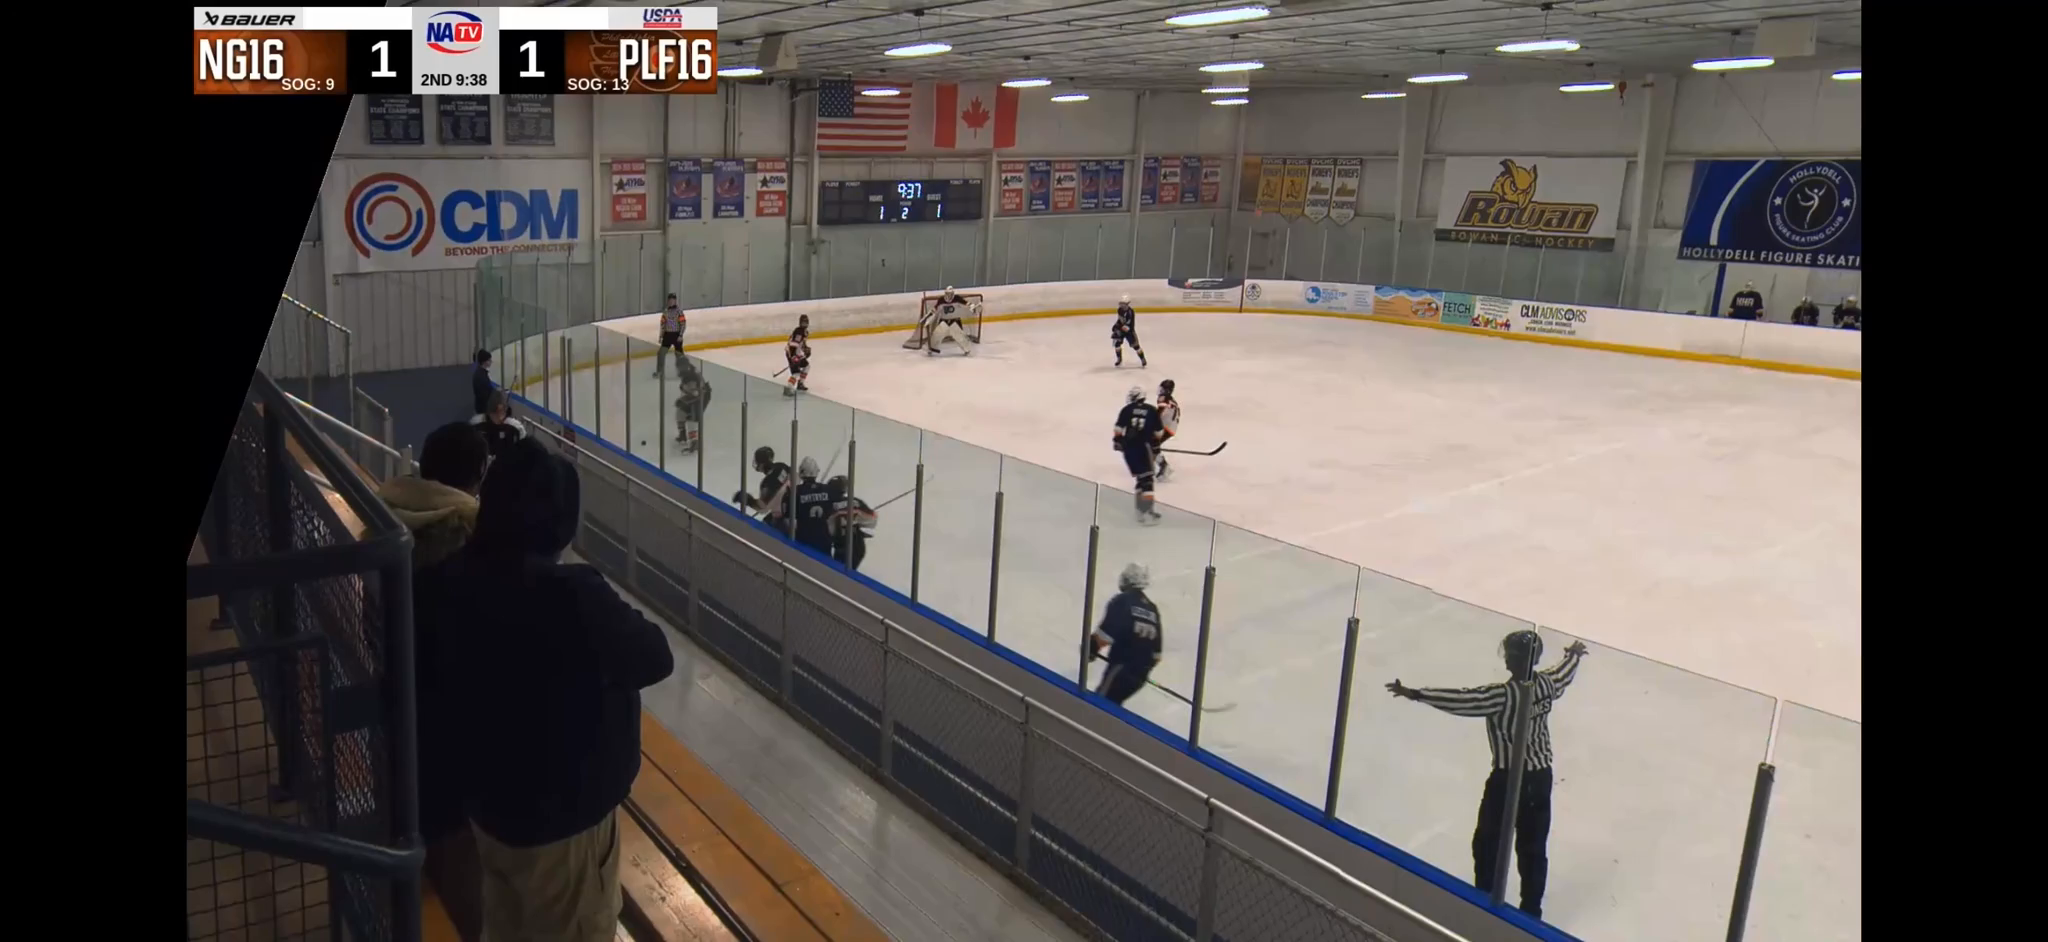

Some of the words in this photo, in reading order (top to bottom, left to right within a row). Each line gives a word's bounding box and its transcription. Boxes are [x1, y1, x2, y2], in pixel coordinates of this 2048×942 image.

[1789, 165, 1842, 185] HOLLYDELL
[897, 182, 922, 199] 9:37
[440, 188, 578, 244] CDM
[901, 206, 909, 219] 2
[1534, 236, 1595, 249] HOCKEY
[444, 245, 489, 257] BEYOND
[1682, 246, 1756, 261] HOLLYDELL
[1760, 250, 1812, 265] FIGURE
[1443, 302, 1472, 314] FETCH
[1520, 304, 1540, 318] CLM
